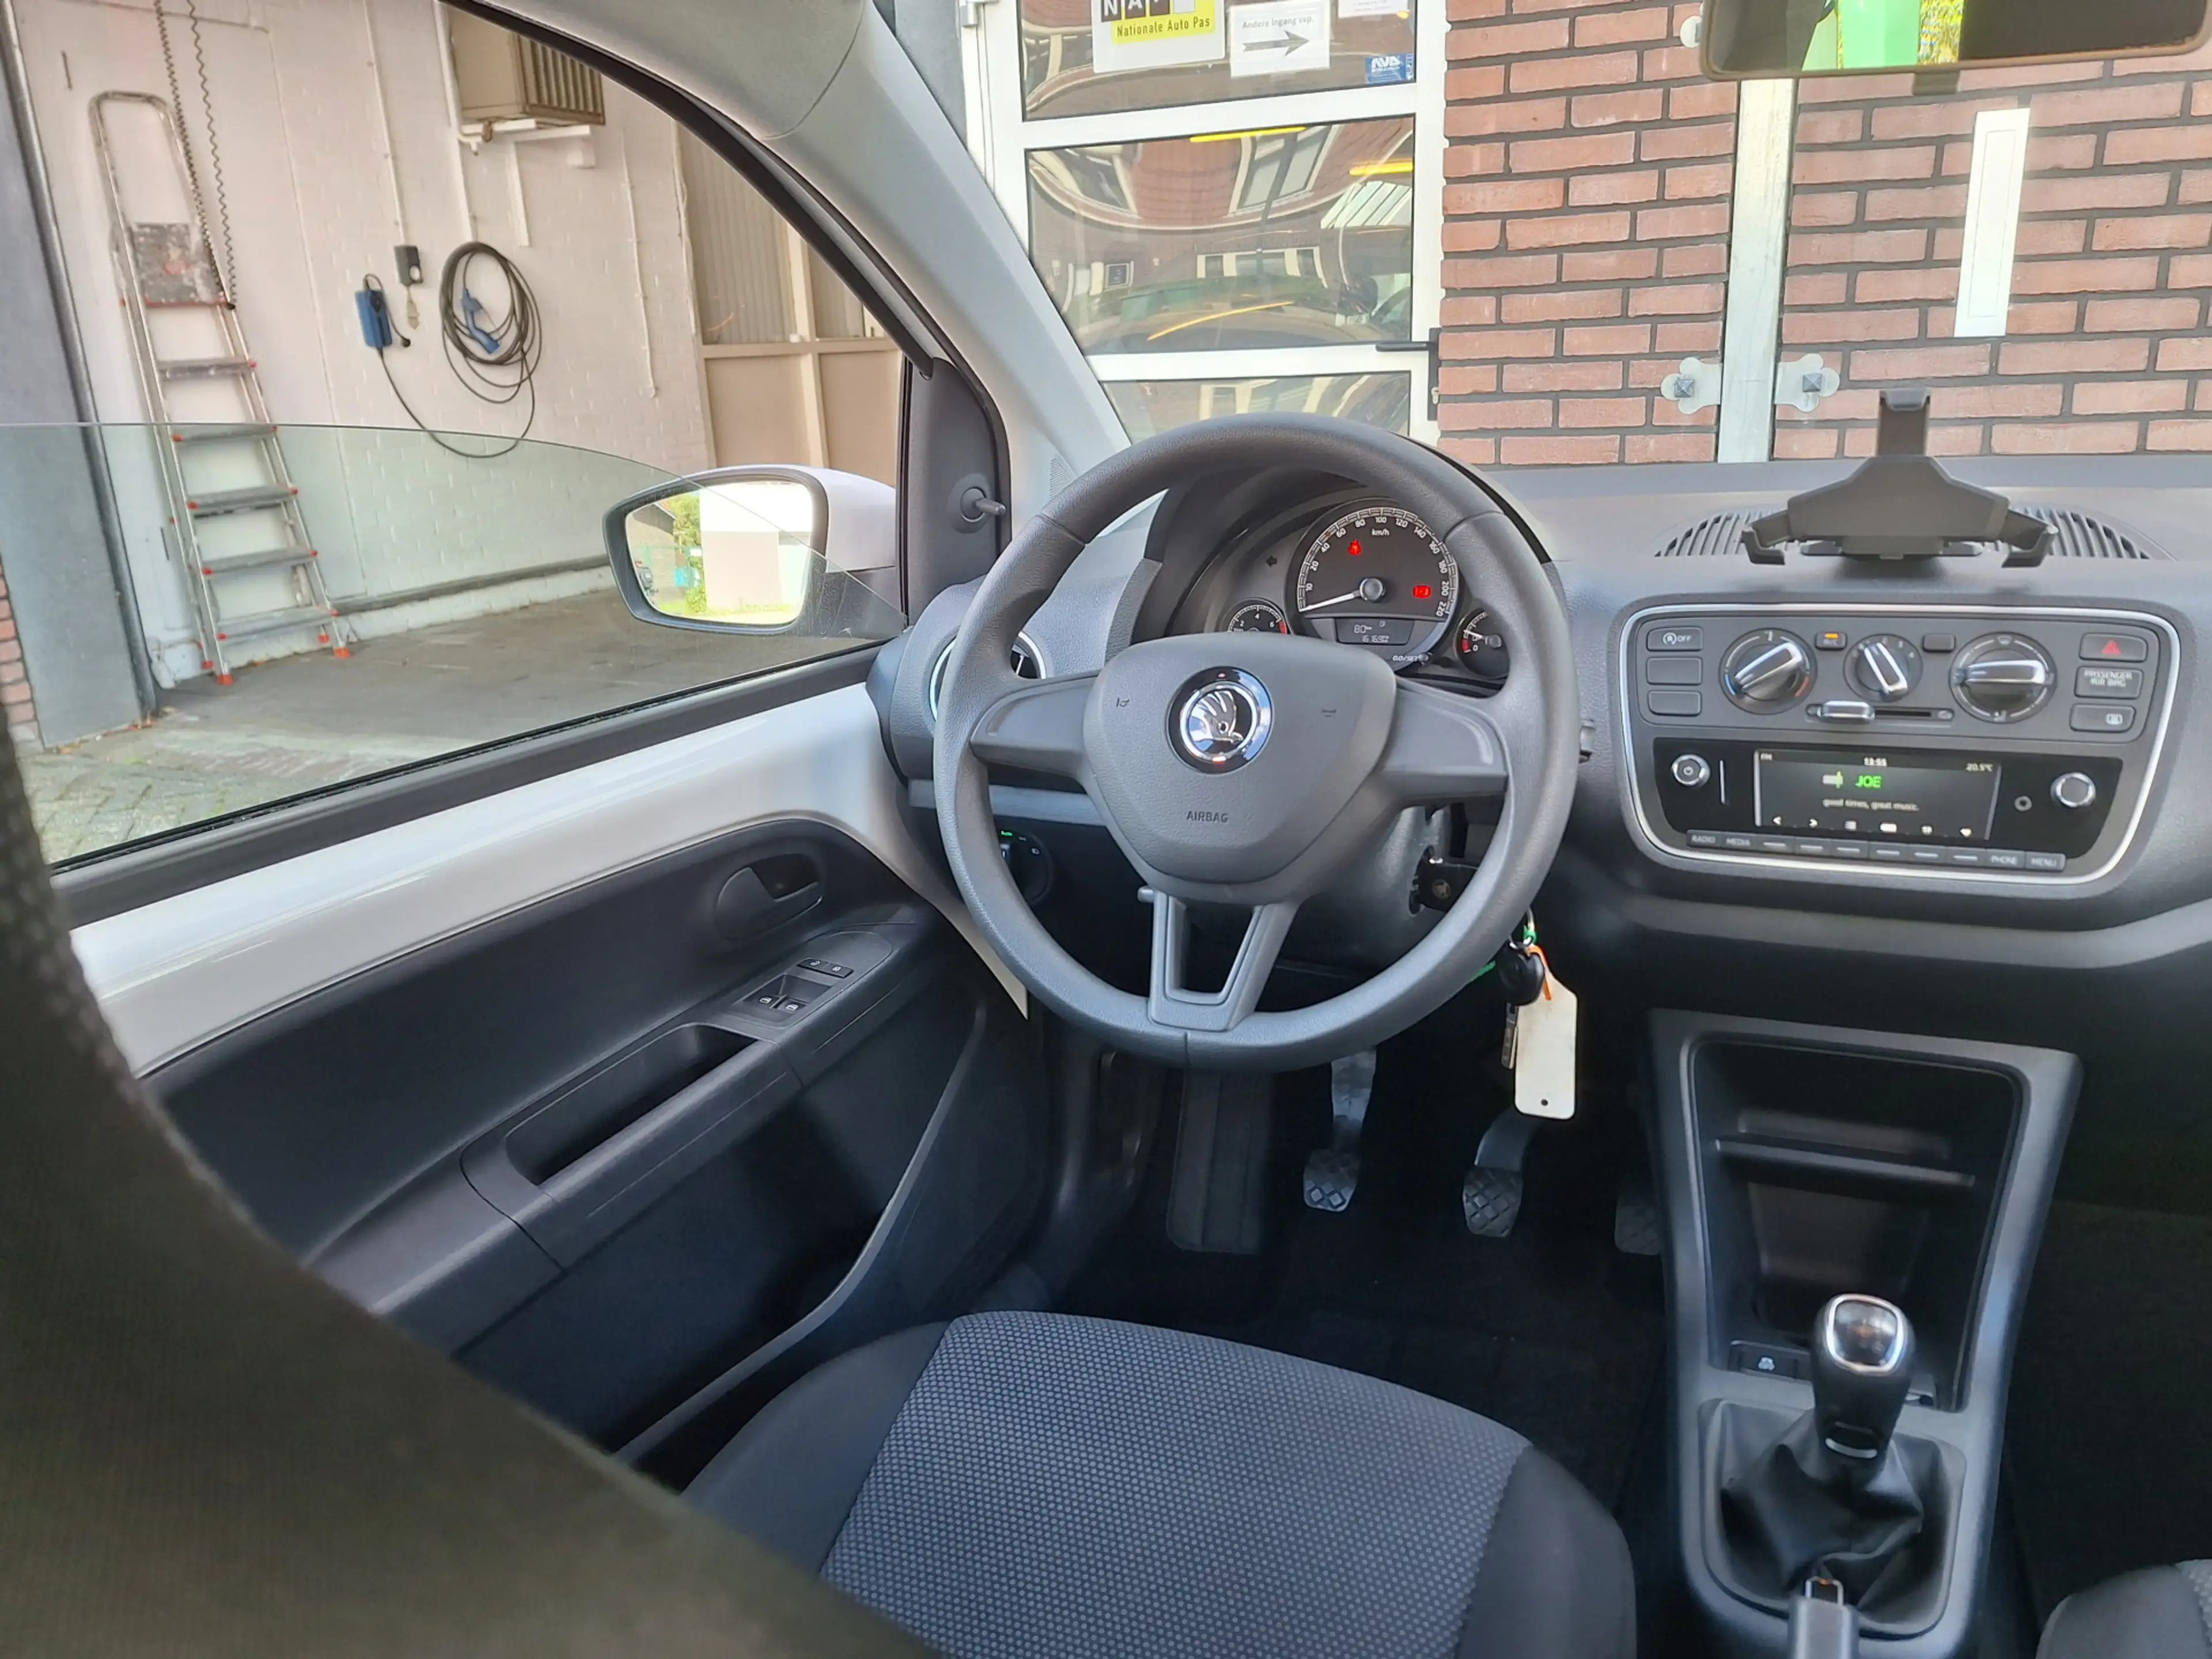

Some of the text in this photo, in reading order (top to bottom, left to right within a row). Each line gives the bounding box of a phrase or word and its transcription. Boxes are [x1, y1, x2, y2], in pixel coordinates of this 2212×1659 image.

[1116, 16, 1210, 37] Nationale Auto Pas
[1241, 20, 1270, 29] Andere
[1354, 519, 1366, 528] 80
[1395, 518, 1408, 528] 120
[1336, 528, 1347, 538] 60
[1413, 527, 1427, 539] 140
[1320, 542, 1331, 553] 40
[1428, 541, 1441, 554] 160
[1310, 560, 1319, 571] 20
[1438, 560, 1448, 574] 180
[1305, 582, 1313, 592] 10
[1441, 580, 1449, 596] 200
[1435, 601, 1447, 617] 220
[1677, 634, 1692, 643] OFF
[1472, 644, 1479, 652] 0
[2084, 669, 2133, 680] PASSENGER
[2107, 677, 2126, 687] BAG
[1854, 774, 1883, 789] JOE
[1185, 810, 1229, 824] AIRBAG
[1691, 834, 1717, 844] RADIO
[1726, 837, 1751, 847] MEDIA
[1990, 855, 2018, 866] PHONE
[2030, 857, 2058, 867] MENU
